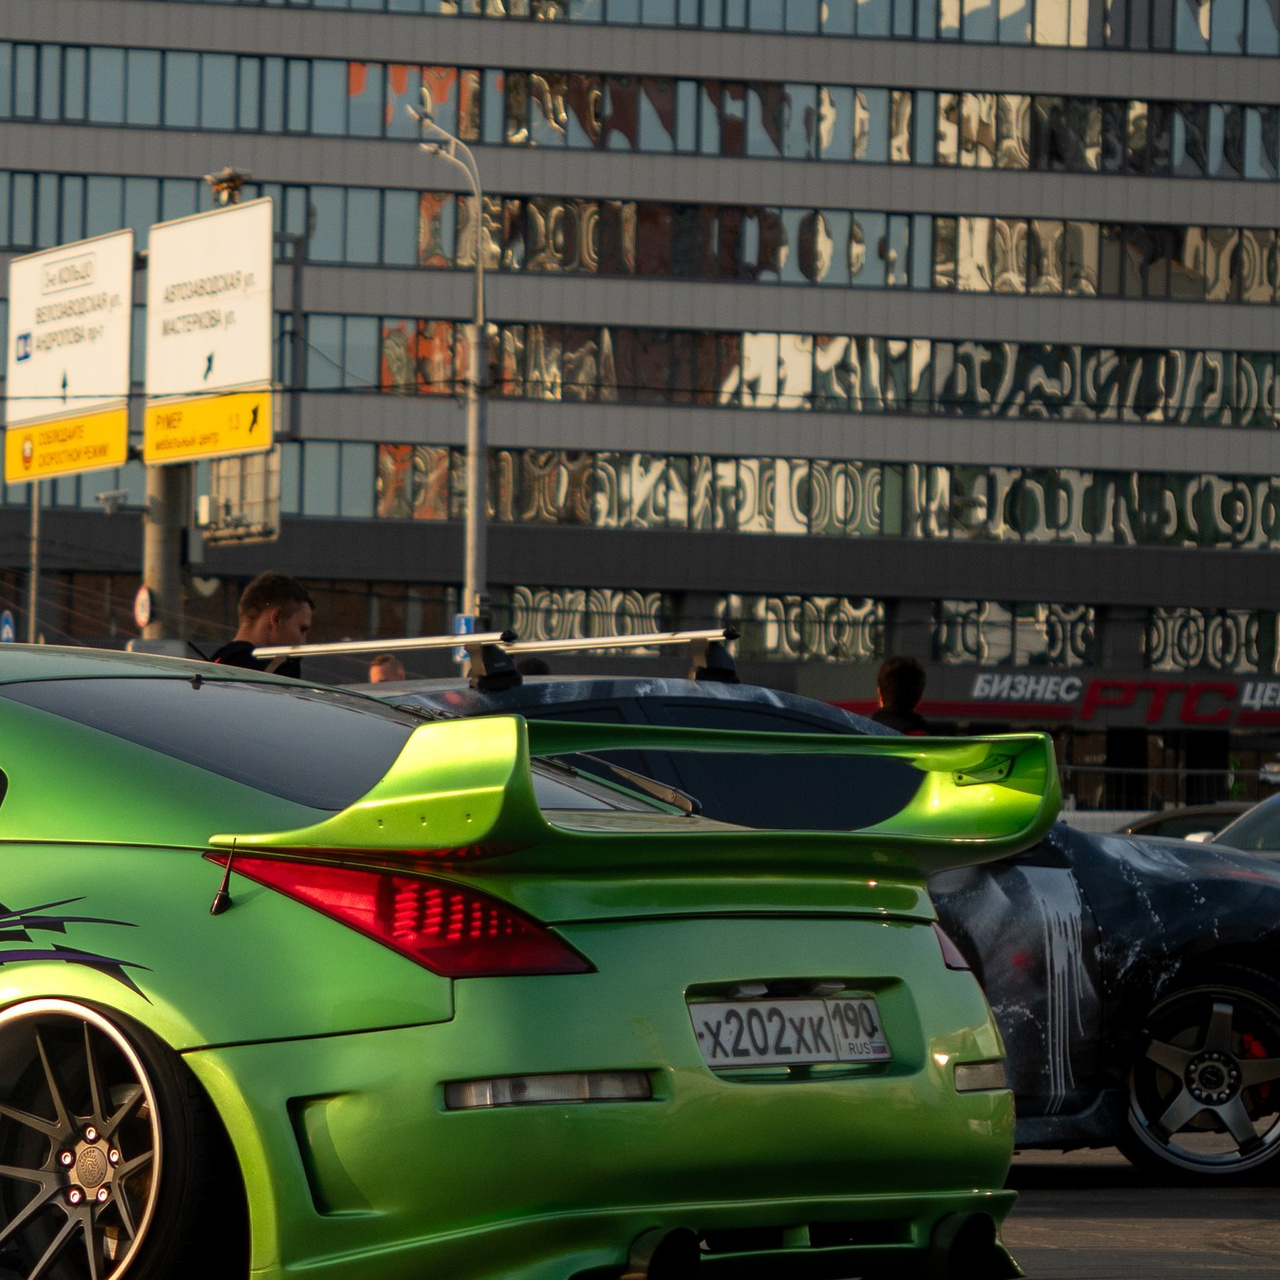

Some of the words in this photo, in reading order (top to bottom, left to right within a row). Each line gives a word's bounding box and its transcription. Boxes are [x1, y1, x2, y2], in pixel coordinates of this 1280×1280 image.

[58, 261, 93, 284] КОЛЬЦО
[164, 270, 241, 303] АВТОЗАВОДСКАЯ
[162, 309, 221, 336] МАСТЕРКОВА
[36, 326, 85, 352] АНДРОПОВА
[973, 673, 1083, 702] БИЗНЕС
[1079, 680, 1238, 724] РТС
[1241, 682, 1280, 711] ЦЕ
[832, 1002, 876, 1039] 190
[848, 1042, 871, 1055] RUS
